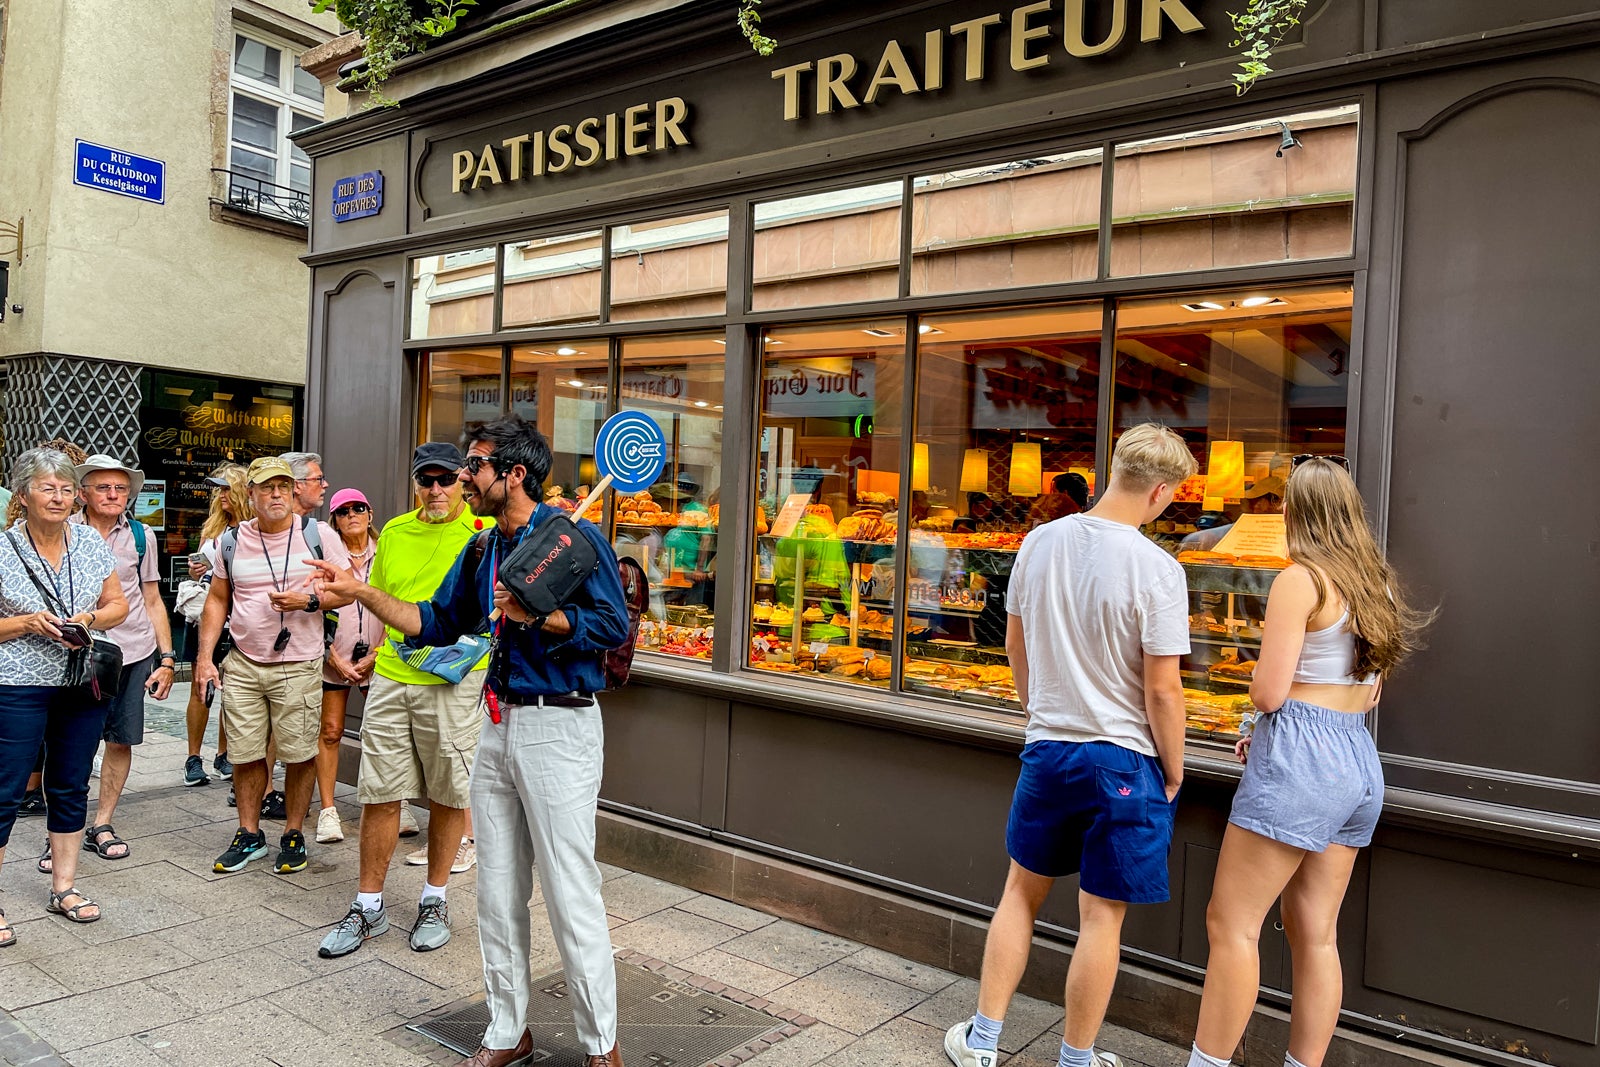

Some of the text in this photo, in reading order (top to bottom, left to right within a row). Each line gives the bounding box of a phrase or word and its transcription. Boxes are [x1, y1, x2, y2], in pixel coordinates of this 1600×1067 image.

[452, 0, 1206, 194] PATISSIER TRAITEUR
[110, 152, 132, 166] RUE
[82, 158, 157, 184] DU CHAUDRON
[93, 173, 147, 194] Kesselgässel
[338, 177, 375, 198] RUE DES
[334, 195, 377, 216] ORFEVRES
[213, 407, 282, 430] Wolfberger
[179, 429, 247, 449] Wolfberger
